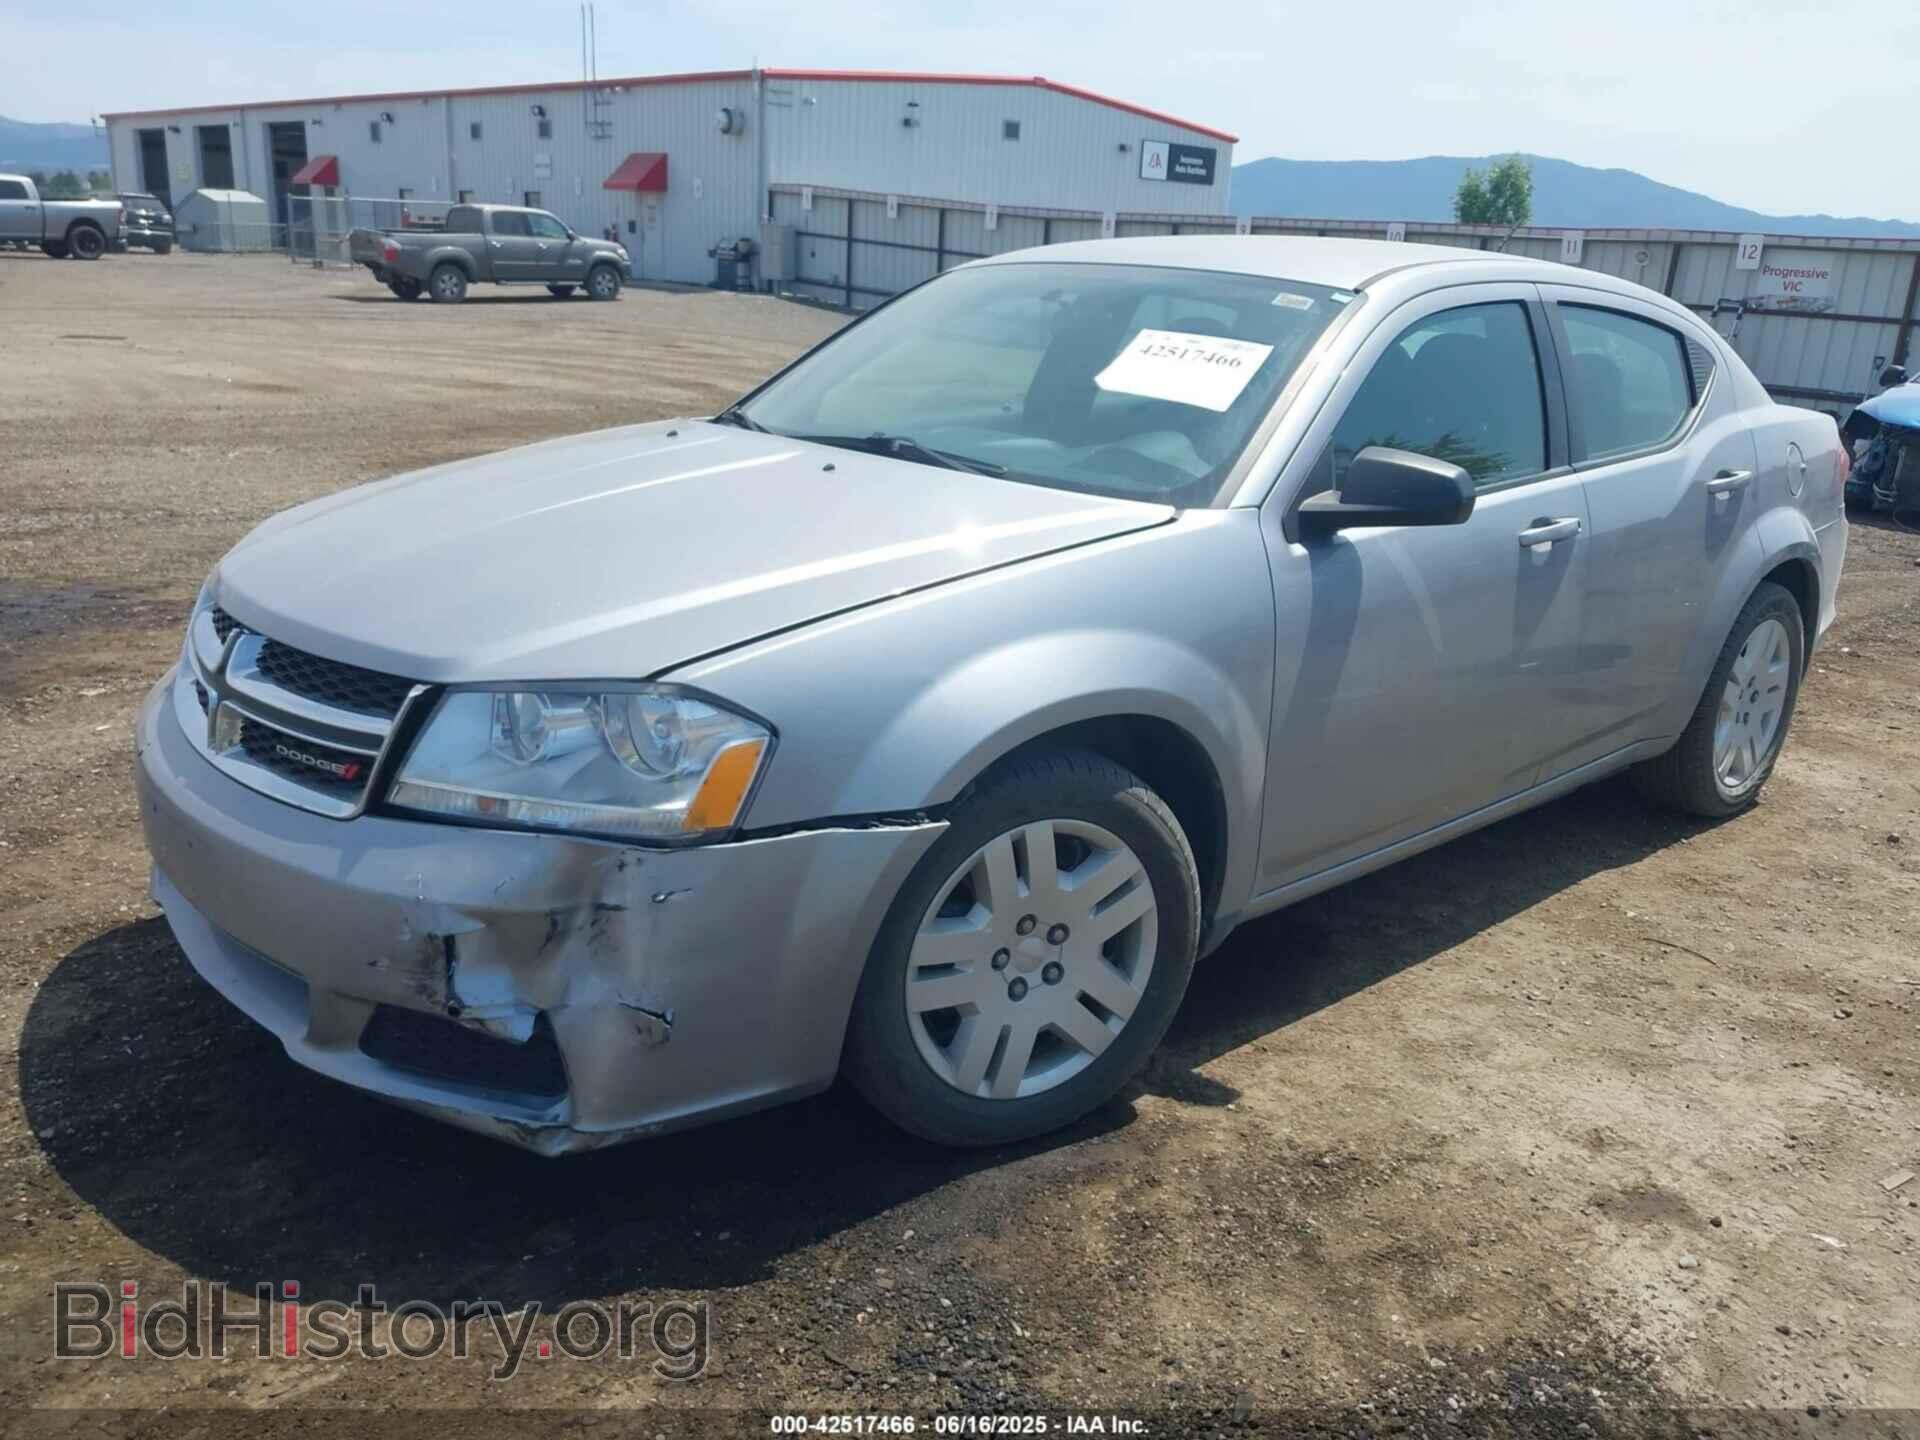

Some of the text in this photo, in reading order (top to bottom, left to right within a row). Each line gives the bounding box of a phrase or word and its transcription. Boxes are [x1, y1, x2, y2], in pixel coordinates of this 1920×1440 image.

[1741, 243, 1759, 260] 12
[1762, 264, 1829, 280] Progressive
[1782, 281, 1803, 293] VIC
[1140, 344, 1243, 369] 42517466
[275, 743, 347, 775] DODGE
